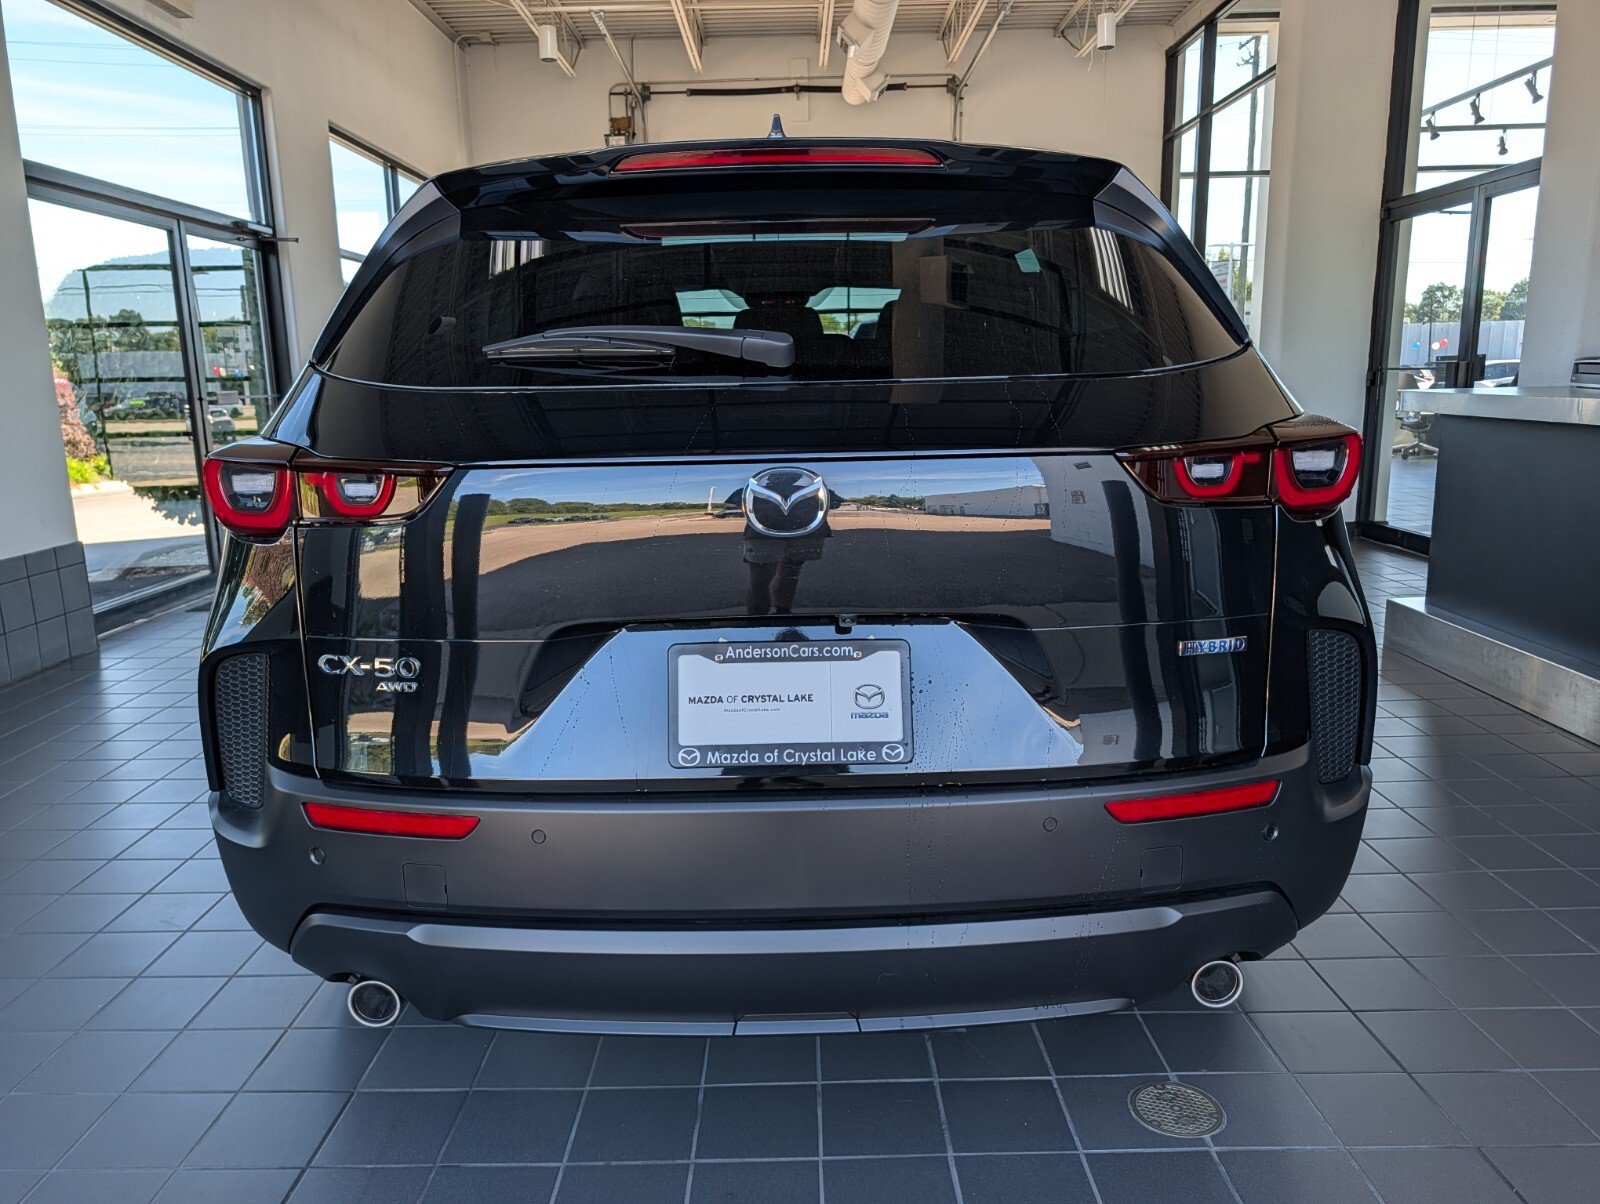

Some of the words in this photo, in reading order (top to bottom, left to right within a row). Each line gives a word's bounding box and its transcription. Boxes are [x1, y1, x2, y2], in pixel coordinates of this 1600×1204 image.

[725, 644, 853, 659] AndersonCars.com
[1186, 637, 1246, 655] HYBRID
[318, 654, 421, 678] CX-50
[375, 681, 418, 693] AWD
[688, 696, 724, 705] MAZDA
[726, 695, 738, 704] OF
[741, 694, 784, 704] CRYSTAL
[787, 693, 814, 703] LAKE
[706, 750, 759, 765] Mazda
[764, 749, 779, 763] of
[783, 749, 835, 766] Crystal
[840, 747, 877, 761] Lake
